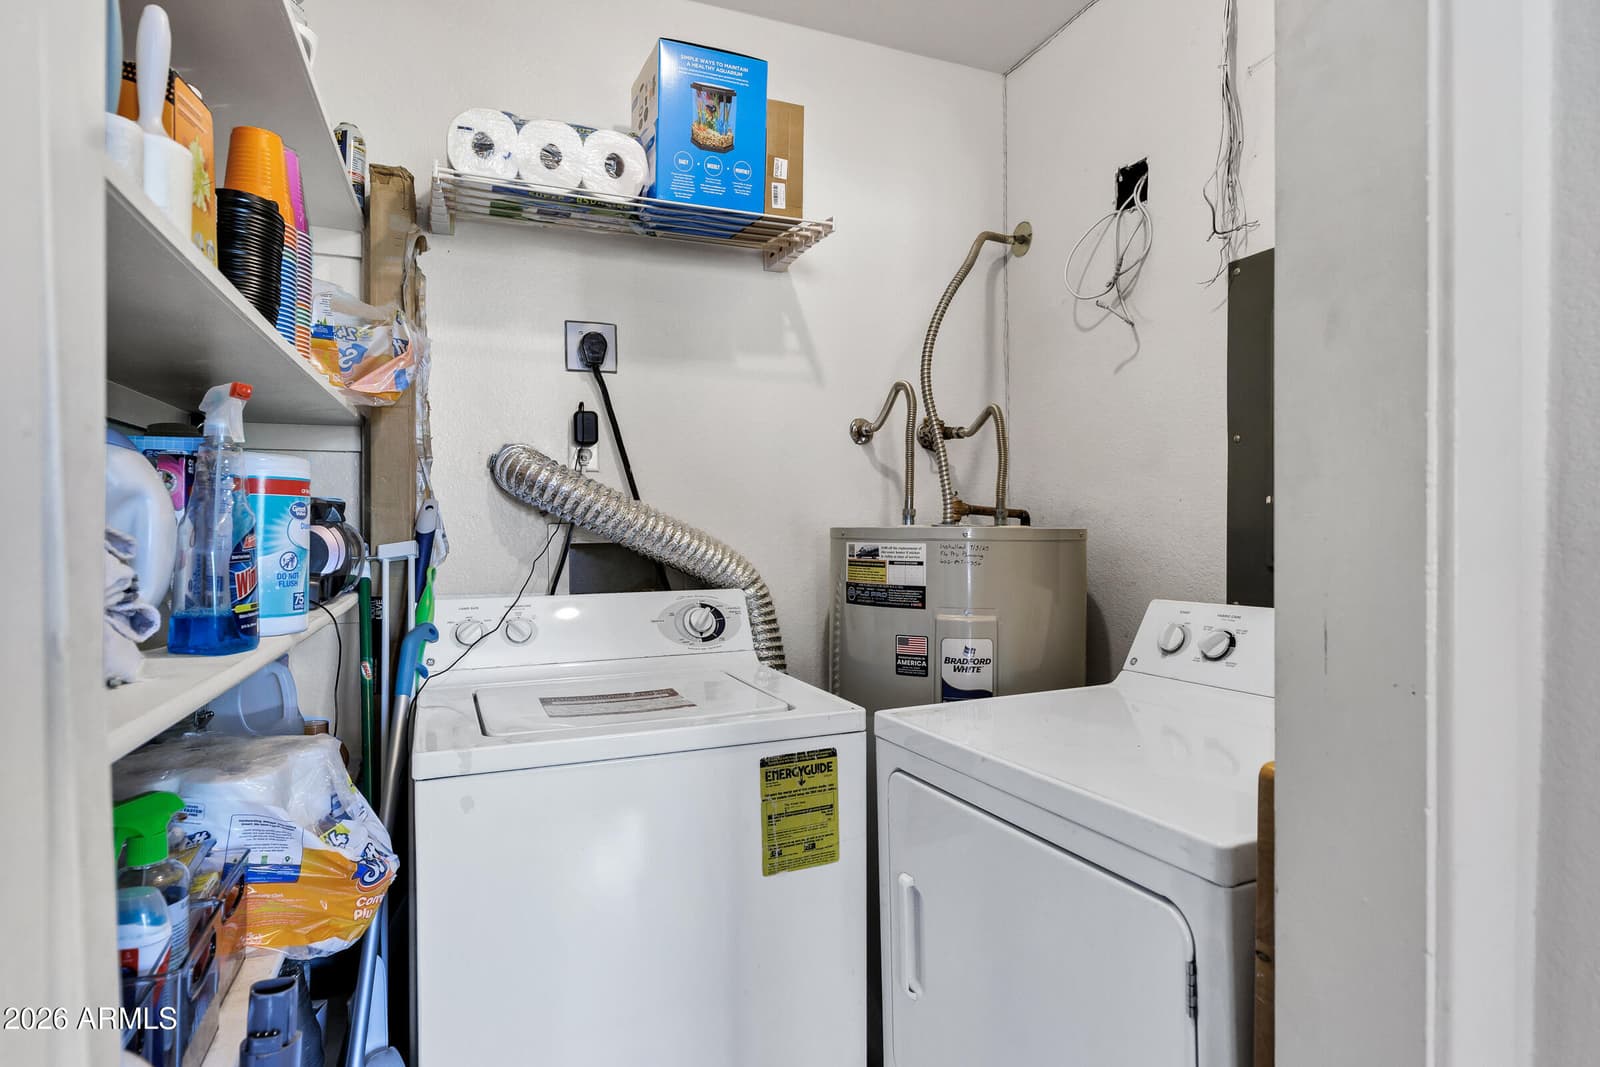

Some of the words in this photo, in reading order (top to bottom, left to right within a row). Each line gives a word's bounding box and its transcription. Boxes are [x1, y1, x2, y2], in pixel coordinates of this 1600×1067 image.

[692, 62, 715, 72] HEALTHY
[716, 68, 743, 77] AQUARIUM
[700, 58, 715, 66] WAYS
[724, 63, 749, 73] MAINTAIN
[276, 572, 286, 580] DO
[288, 572, 299, 580] NOT
[278, 580, 298, 588] FLUSH
[294, 593, 304, 604] 75
[896, 658, 927, 667] AMERICA
[943, 656, 992, 666] BRADFORD
[952, 665, 983, 674] WHITE
[765, 761, 833, 783] ENERGYGUIDE
